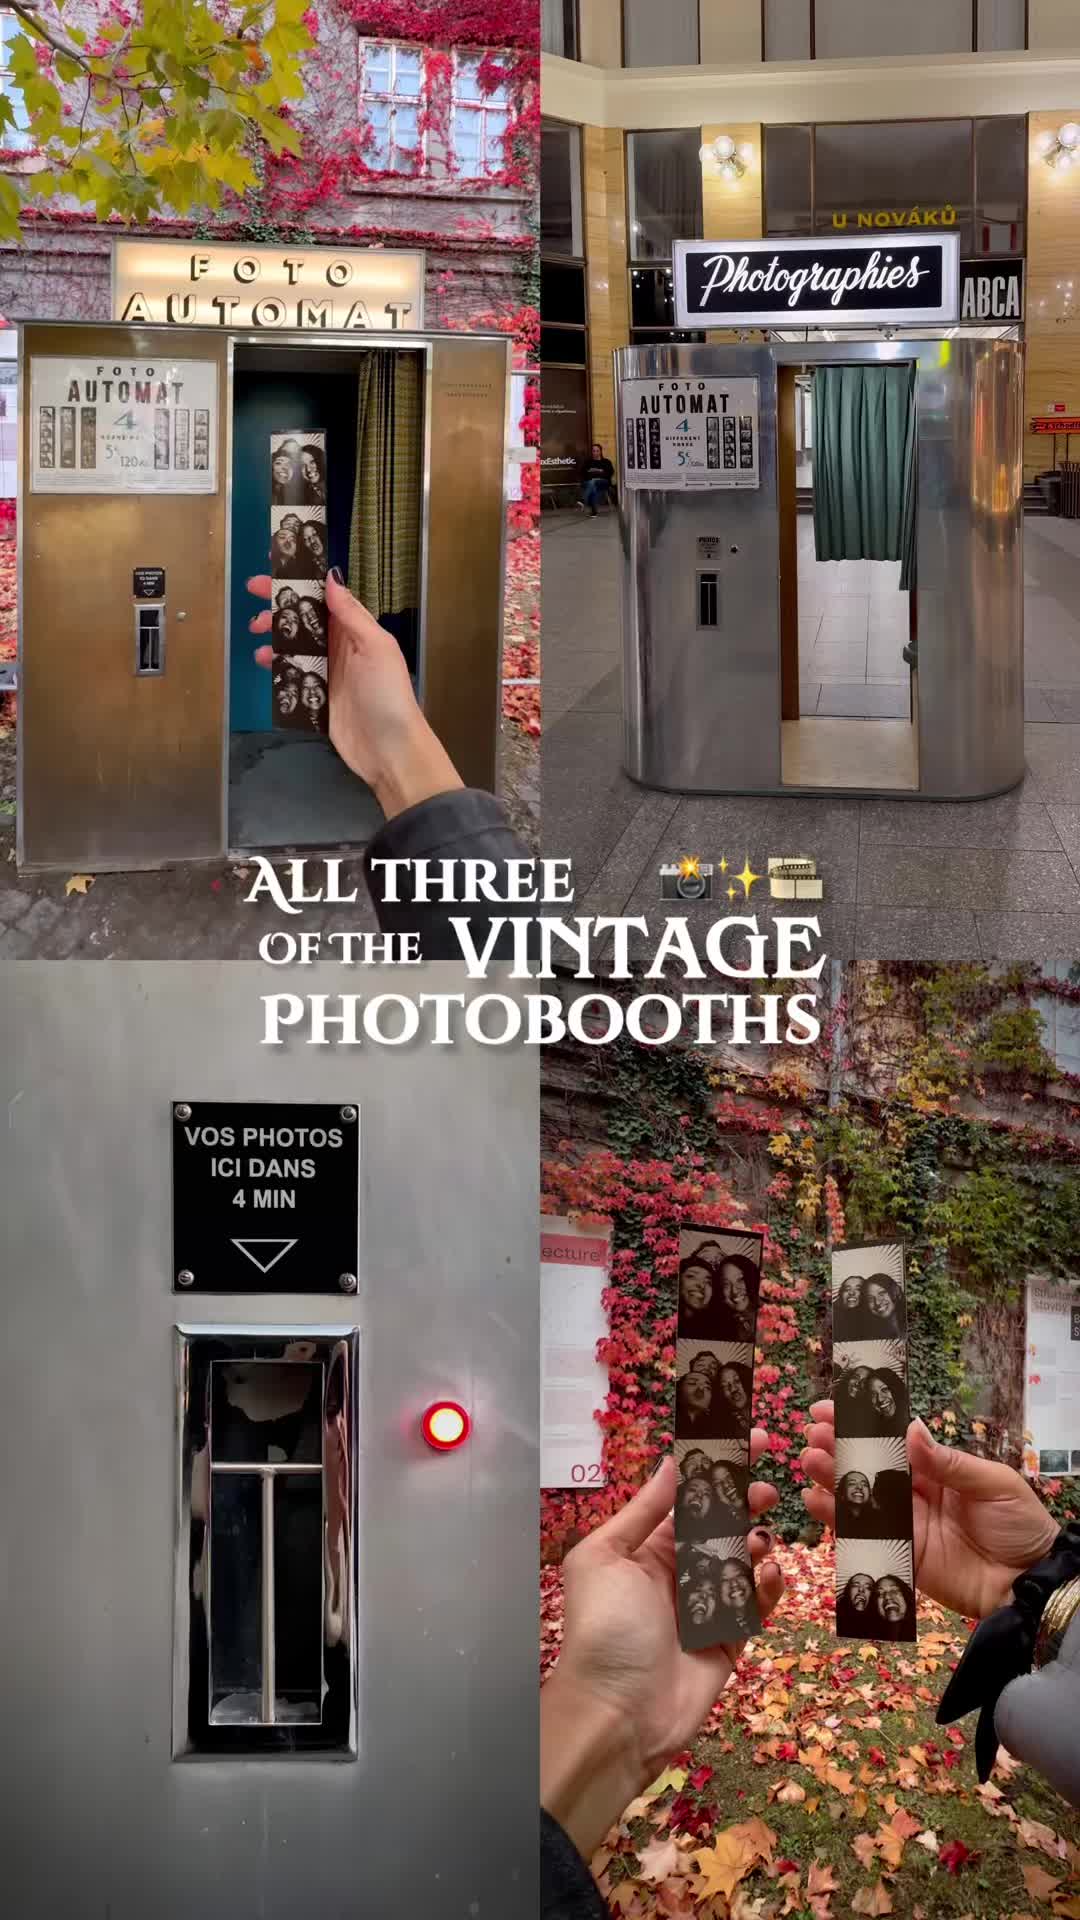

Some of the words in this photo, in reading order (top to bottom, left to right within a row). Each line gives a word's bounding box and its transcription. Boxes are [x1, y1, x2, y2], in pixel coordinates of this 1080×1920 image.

[832, 213, 847, 229] U
[857, 205, 957, 229] NOVÁKŮ
[190, 254, 354, 287] FOTO
[699, 251, 930, 307] Photographies
[121, 293, 412, 329] AUTOMAT
[96, 366, 155, 377] FOTO
[67, 380, 184, 404] AUTOMAT
[658, 382, 705, 391] FOTO
[640, 394, 729, 414] AUTOMAT
[112, 408, 137, 430] 4
[675, 418, 692, 433] 4
[184, 1126, 236, 1147] VOS
[243, 1127, 344, 1149] PHOTOS
[211, 1157, 241, 1178] ICI
[249, 1158, 316, 1179] DANS
[232, 1188, 246, 1209] 4
[253, 1189, 297, 1209] MIN
